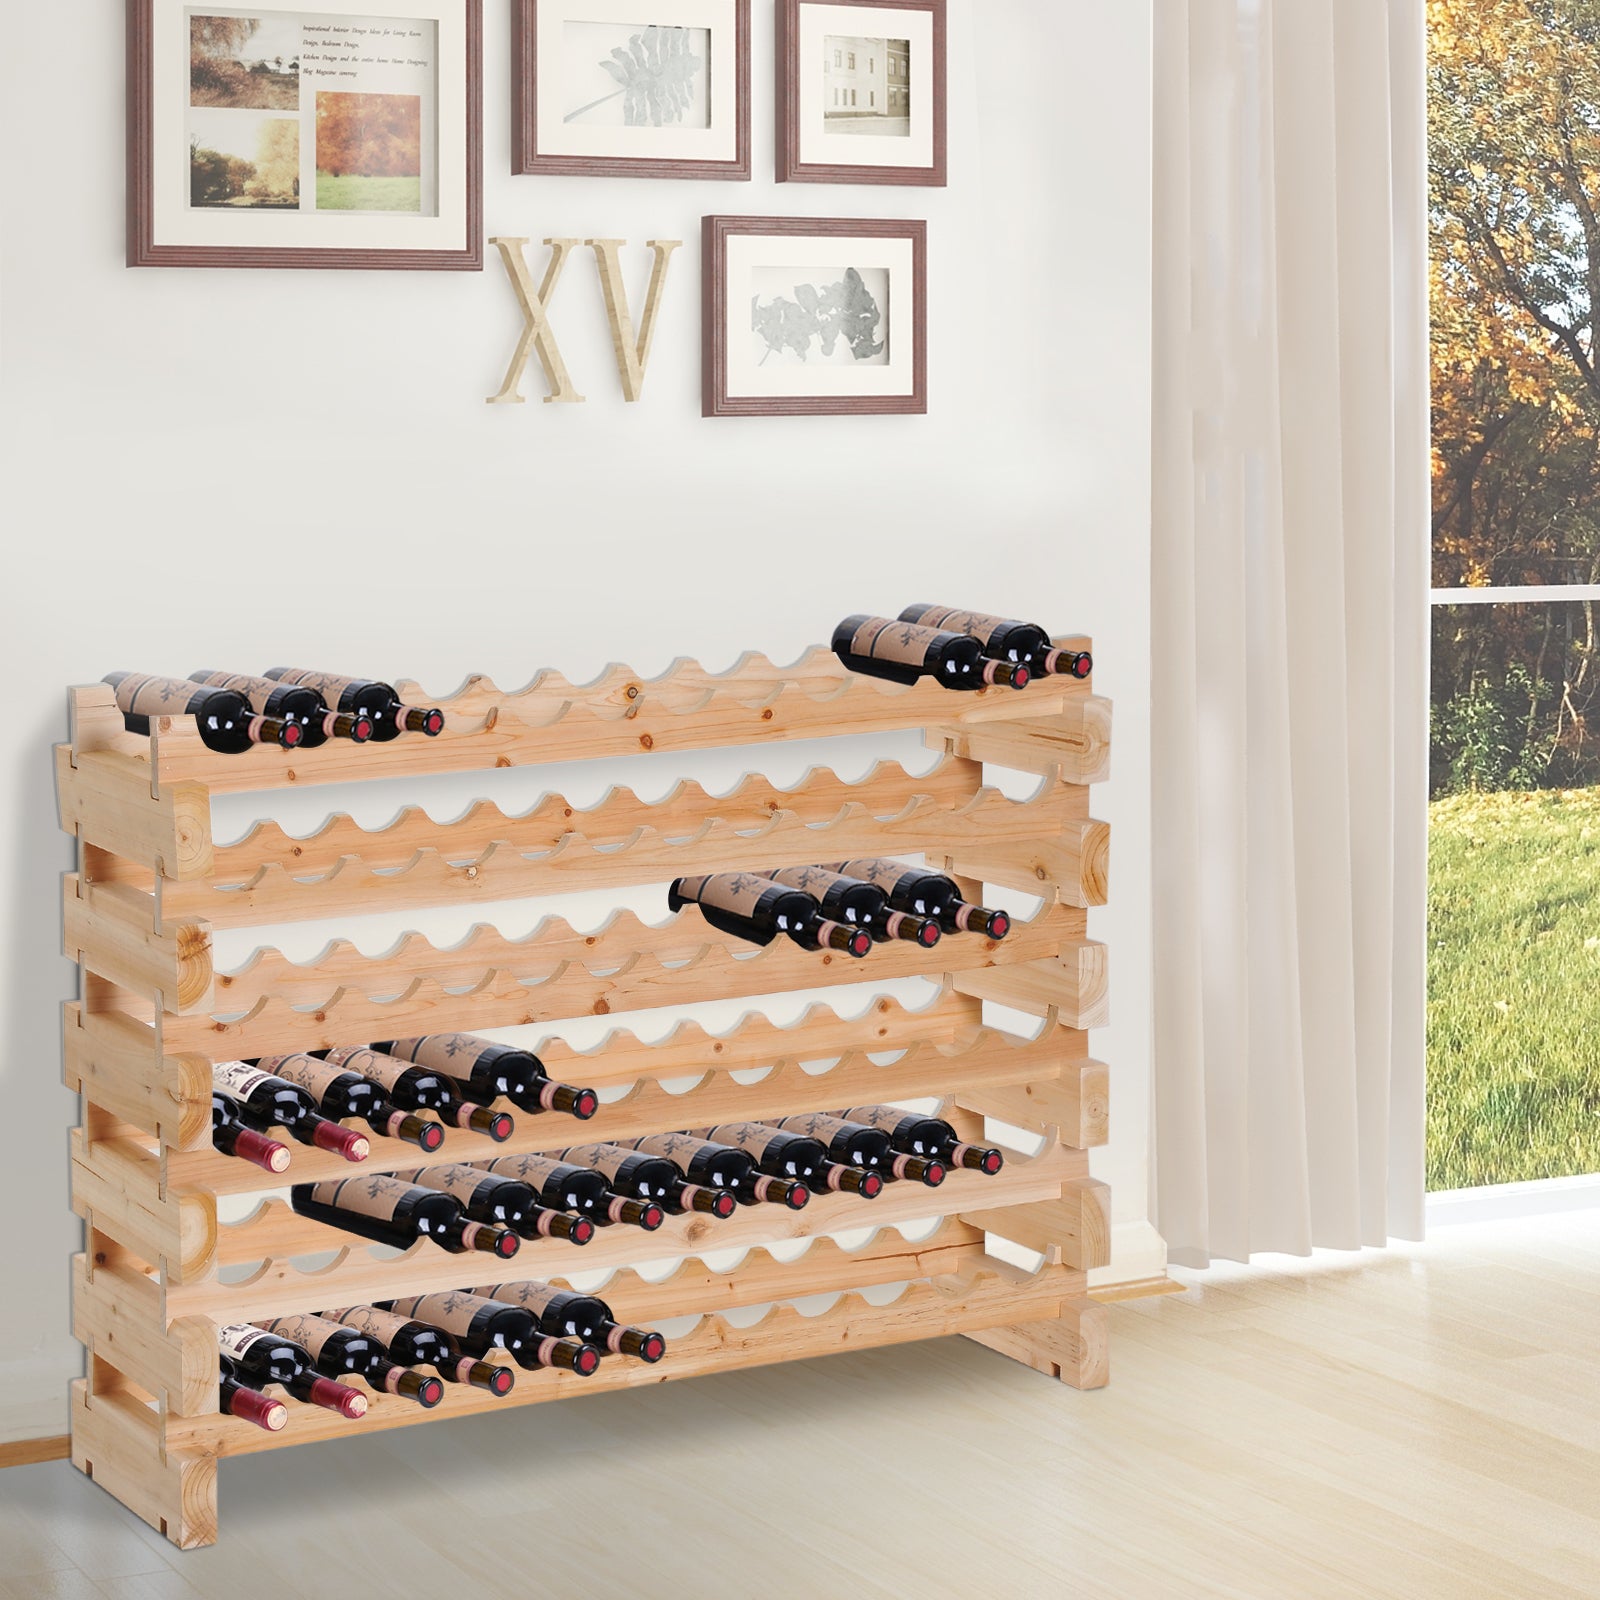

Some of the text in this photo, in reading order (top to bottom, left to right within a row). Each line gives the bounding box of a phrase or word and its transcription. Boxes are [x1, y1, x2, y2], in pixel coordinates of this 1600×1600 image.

[352, 27, 367, 35] Design
[316, 68, 337, 76] Magazine
[485, 237, 683, 403] XV
